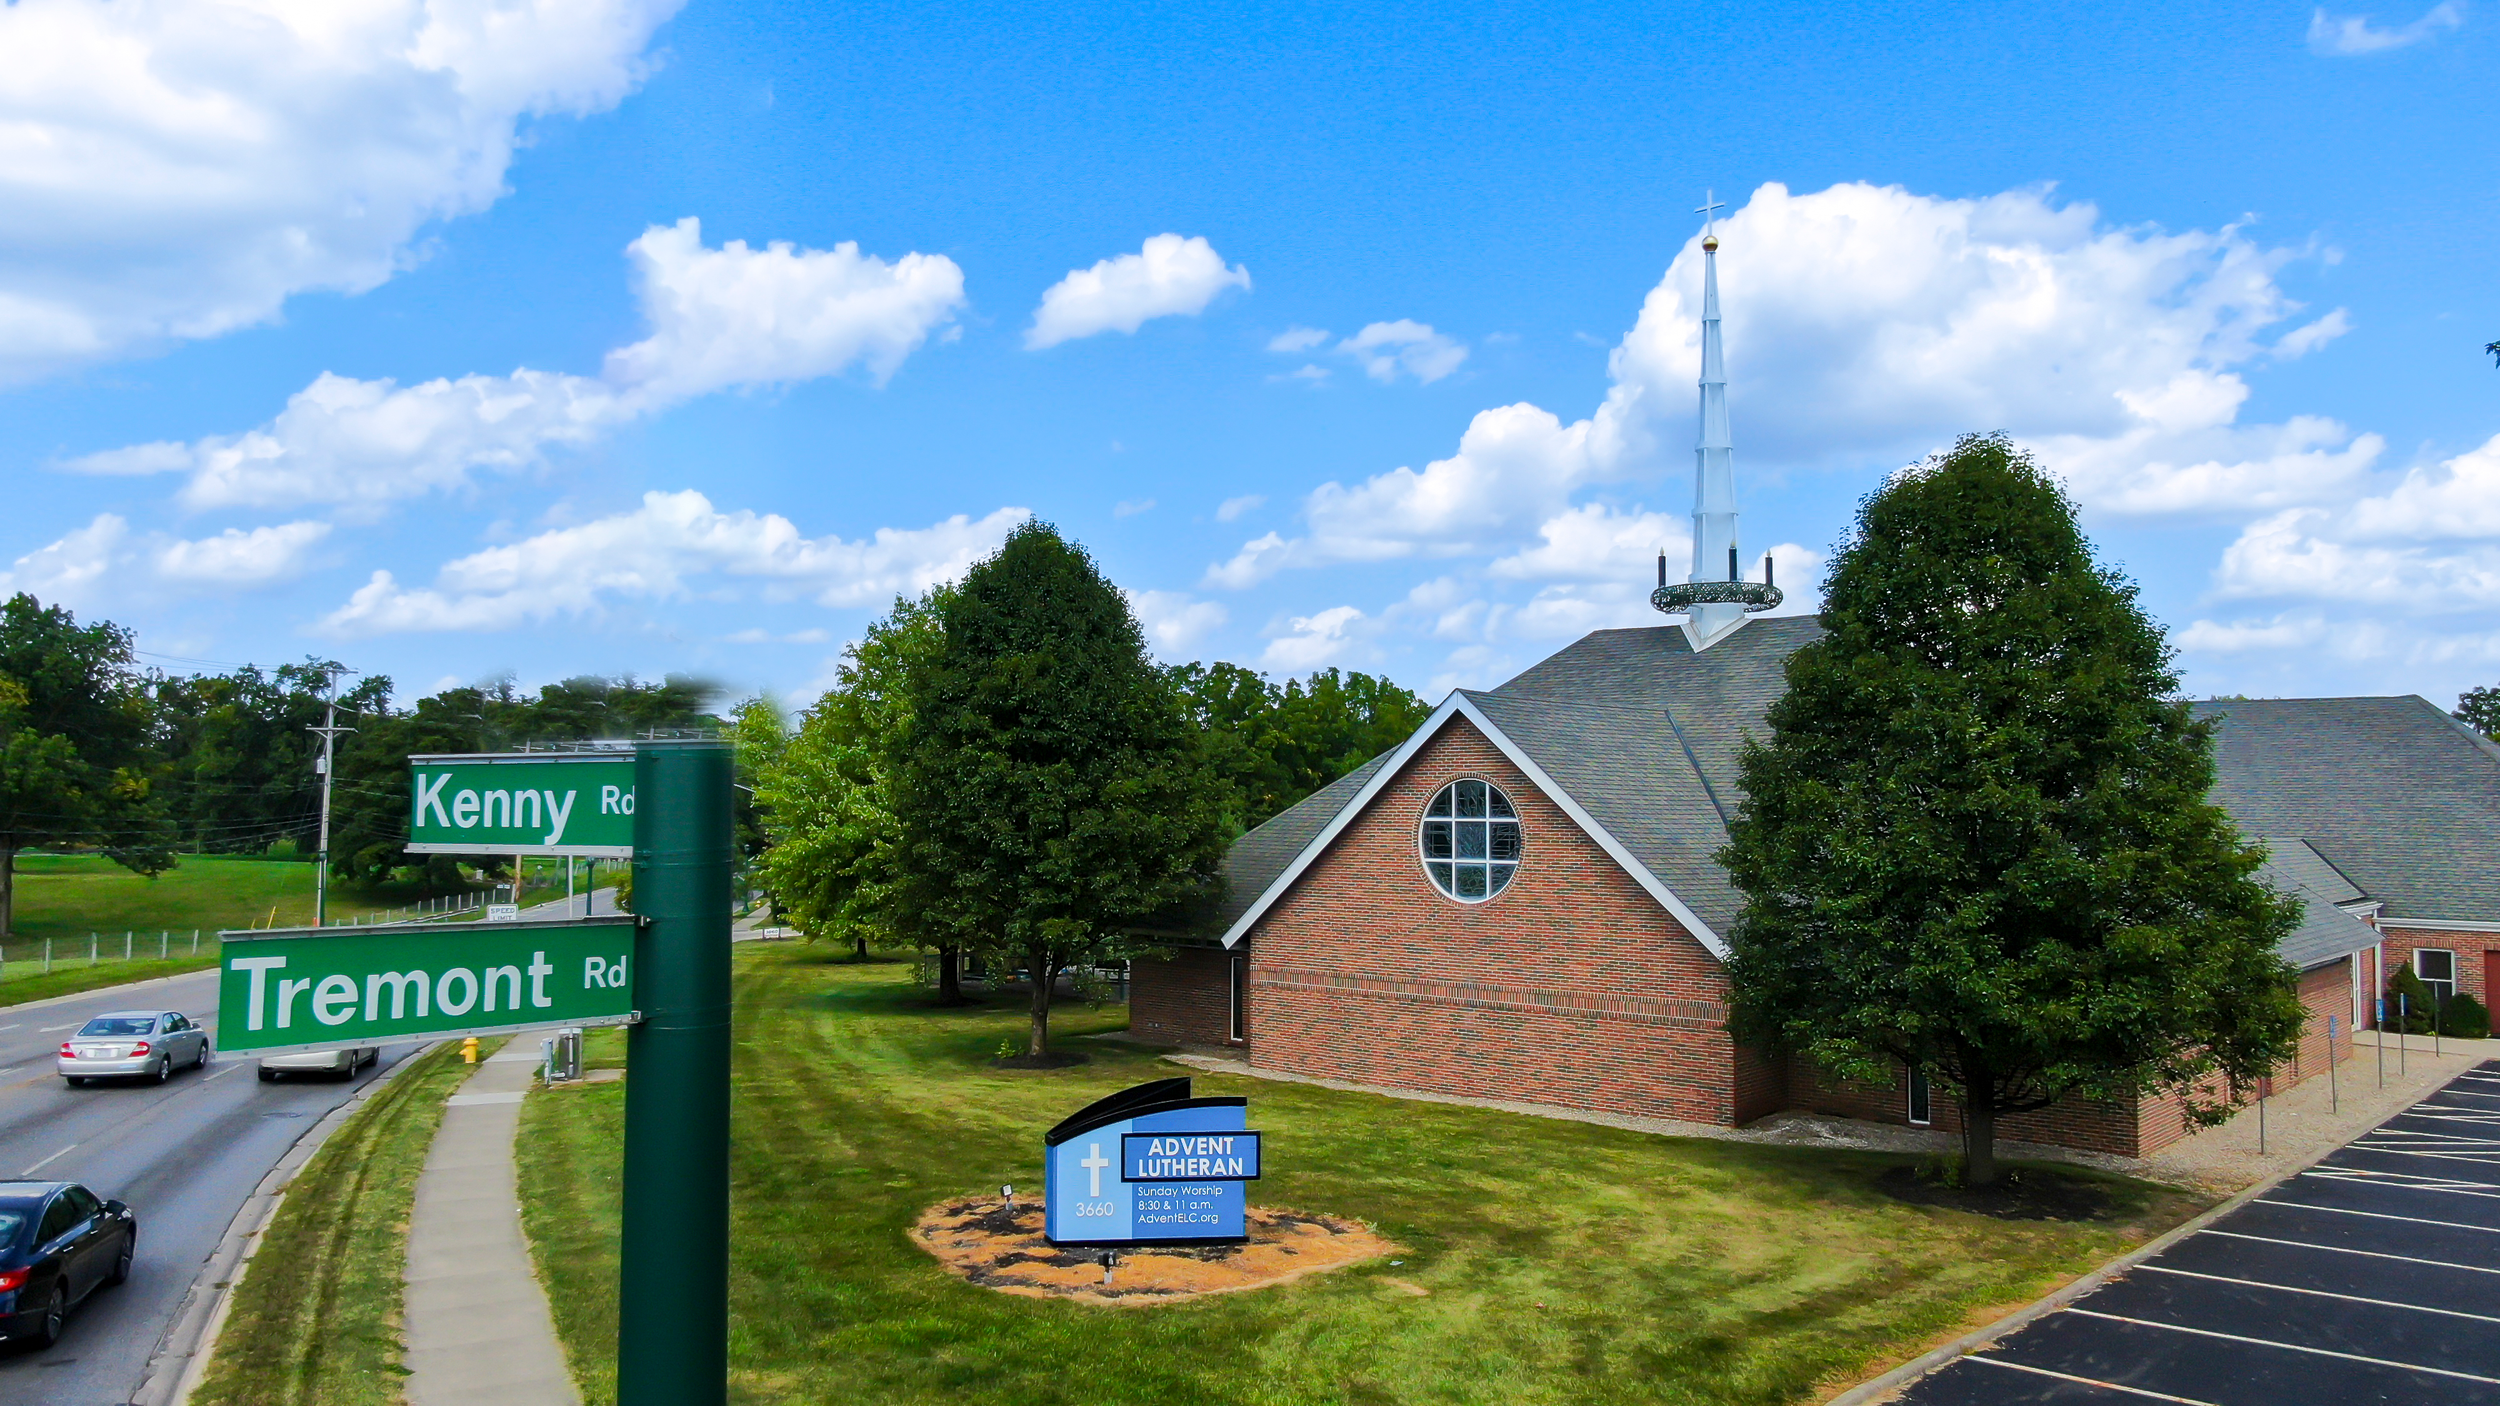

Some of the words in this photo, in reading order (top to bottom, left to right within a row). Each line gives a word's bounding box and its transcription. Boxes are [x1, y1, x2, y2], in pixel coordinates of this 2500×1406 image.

[416, 773, 576, 845] Kenny
[601, 785, 635, 815] Rd
[230, 951, 553, 1031] Tremont
[584, 955, 627, 989] Rd
[1148, 1137, 1234, 1156] ADVENT
[1138, 1158, 1243, 1177] LUTHERAN
[1138, 1186, 1178, 1197] Sunday
[1181, 1185, 1223, 1197] Worship
[1075, 1201, 1114, 1217] 3660
[1138, 1200, 1161, 1211] 8:30
[1163, 1200, 1171, 1210] &
[1175, 1200, 1185, 1210] 11
[1189, 1201, 1214, 1210] a.m.
[1138, 1213, 1219, 1225] AdventELC.org
